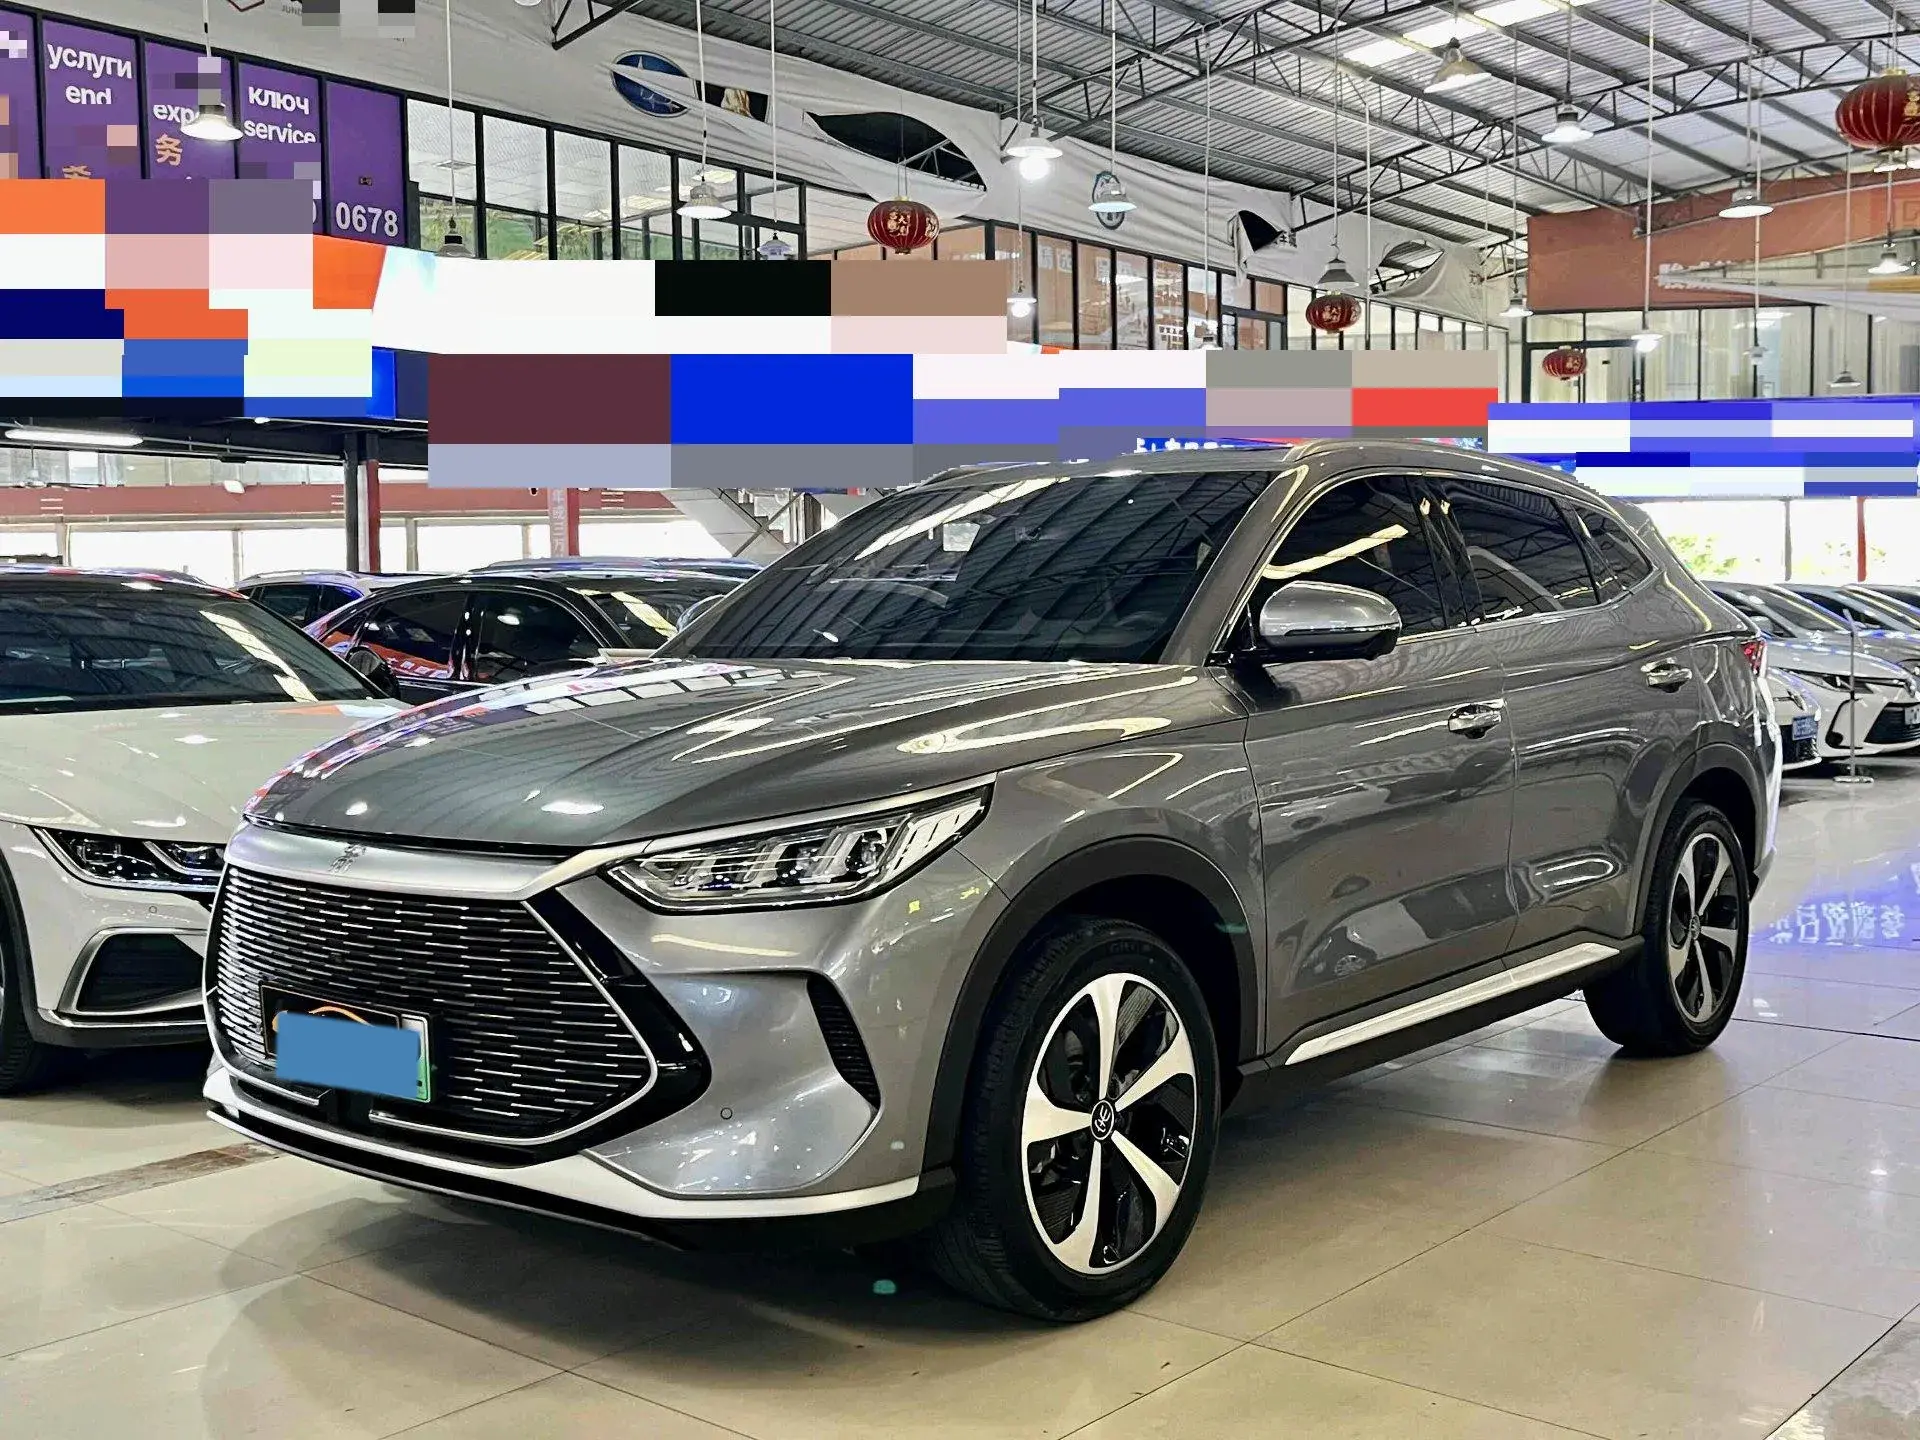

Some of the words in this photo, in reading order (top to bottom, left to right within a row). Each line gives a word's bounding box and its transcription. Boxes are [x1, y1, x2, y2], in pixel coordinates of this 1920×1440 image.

[47, 43, 132, 79] услуги
[65, 85, 111, 105] end
[248, 86, 310, 115] ключ
[244, 120, 317, 144] service
